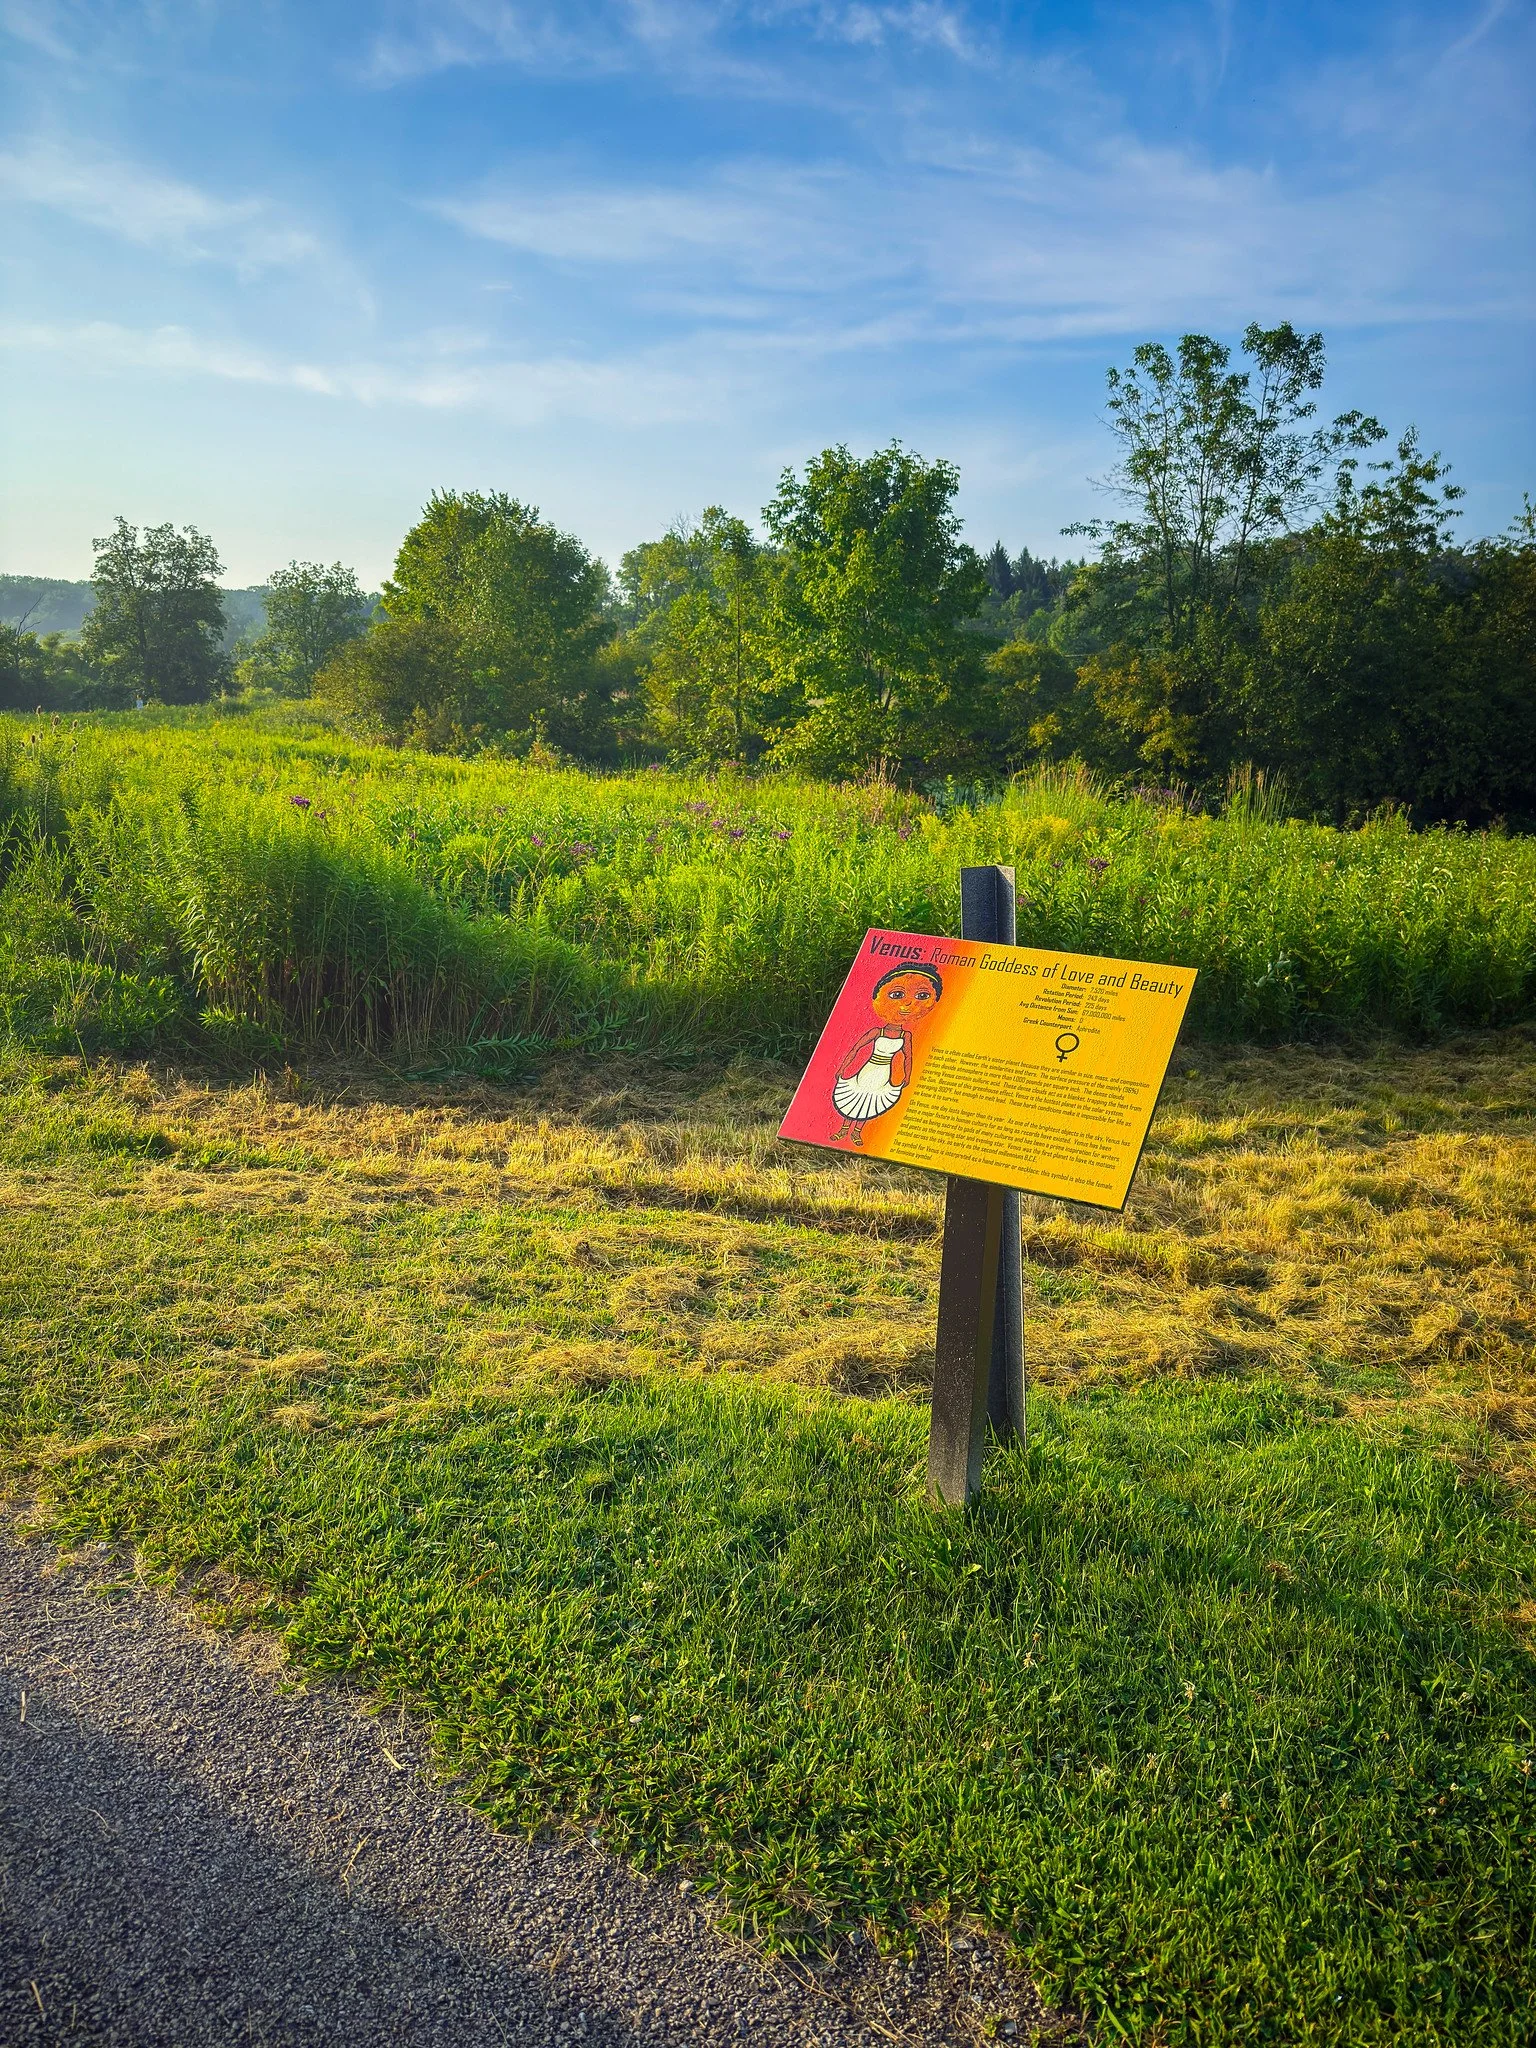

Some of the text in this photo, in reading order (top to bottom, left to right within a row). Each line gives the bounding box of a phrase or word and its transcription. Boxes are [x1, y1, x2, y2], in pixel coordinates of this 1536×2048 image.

[870, 936, 1183, 999] Venus: Roman Goddess of Love and Beauty
[1061, 984, 1087, 992] Diameter:
[1035, 996, 1062, 1004] Revolution
[1062, 999, 1081, 1007] Period:
[1039, 1020, 1073, 1030] Counterpart:
